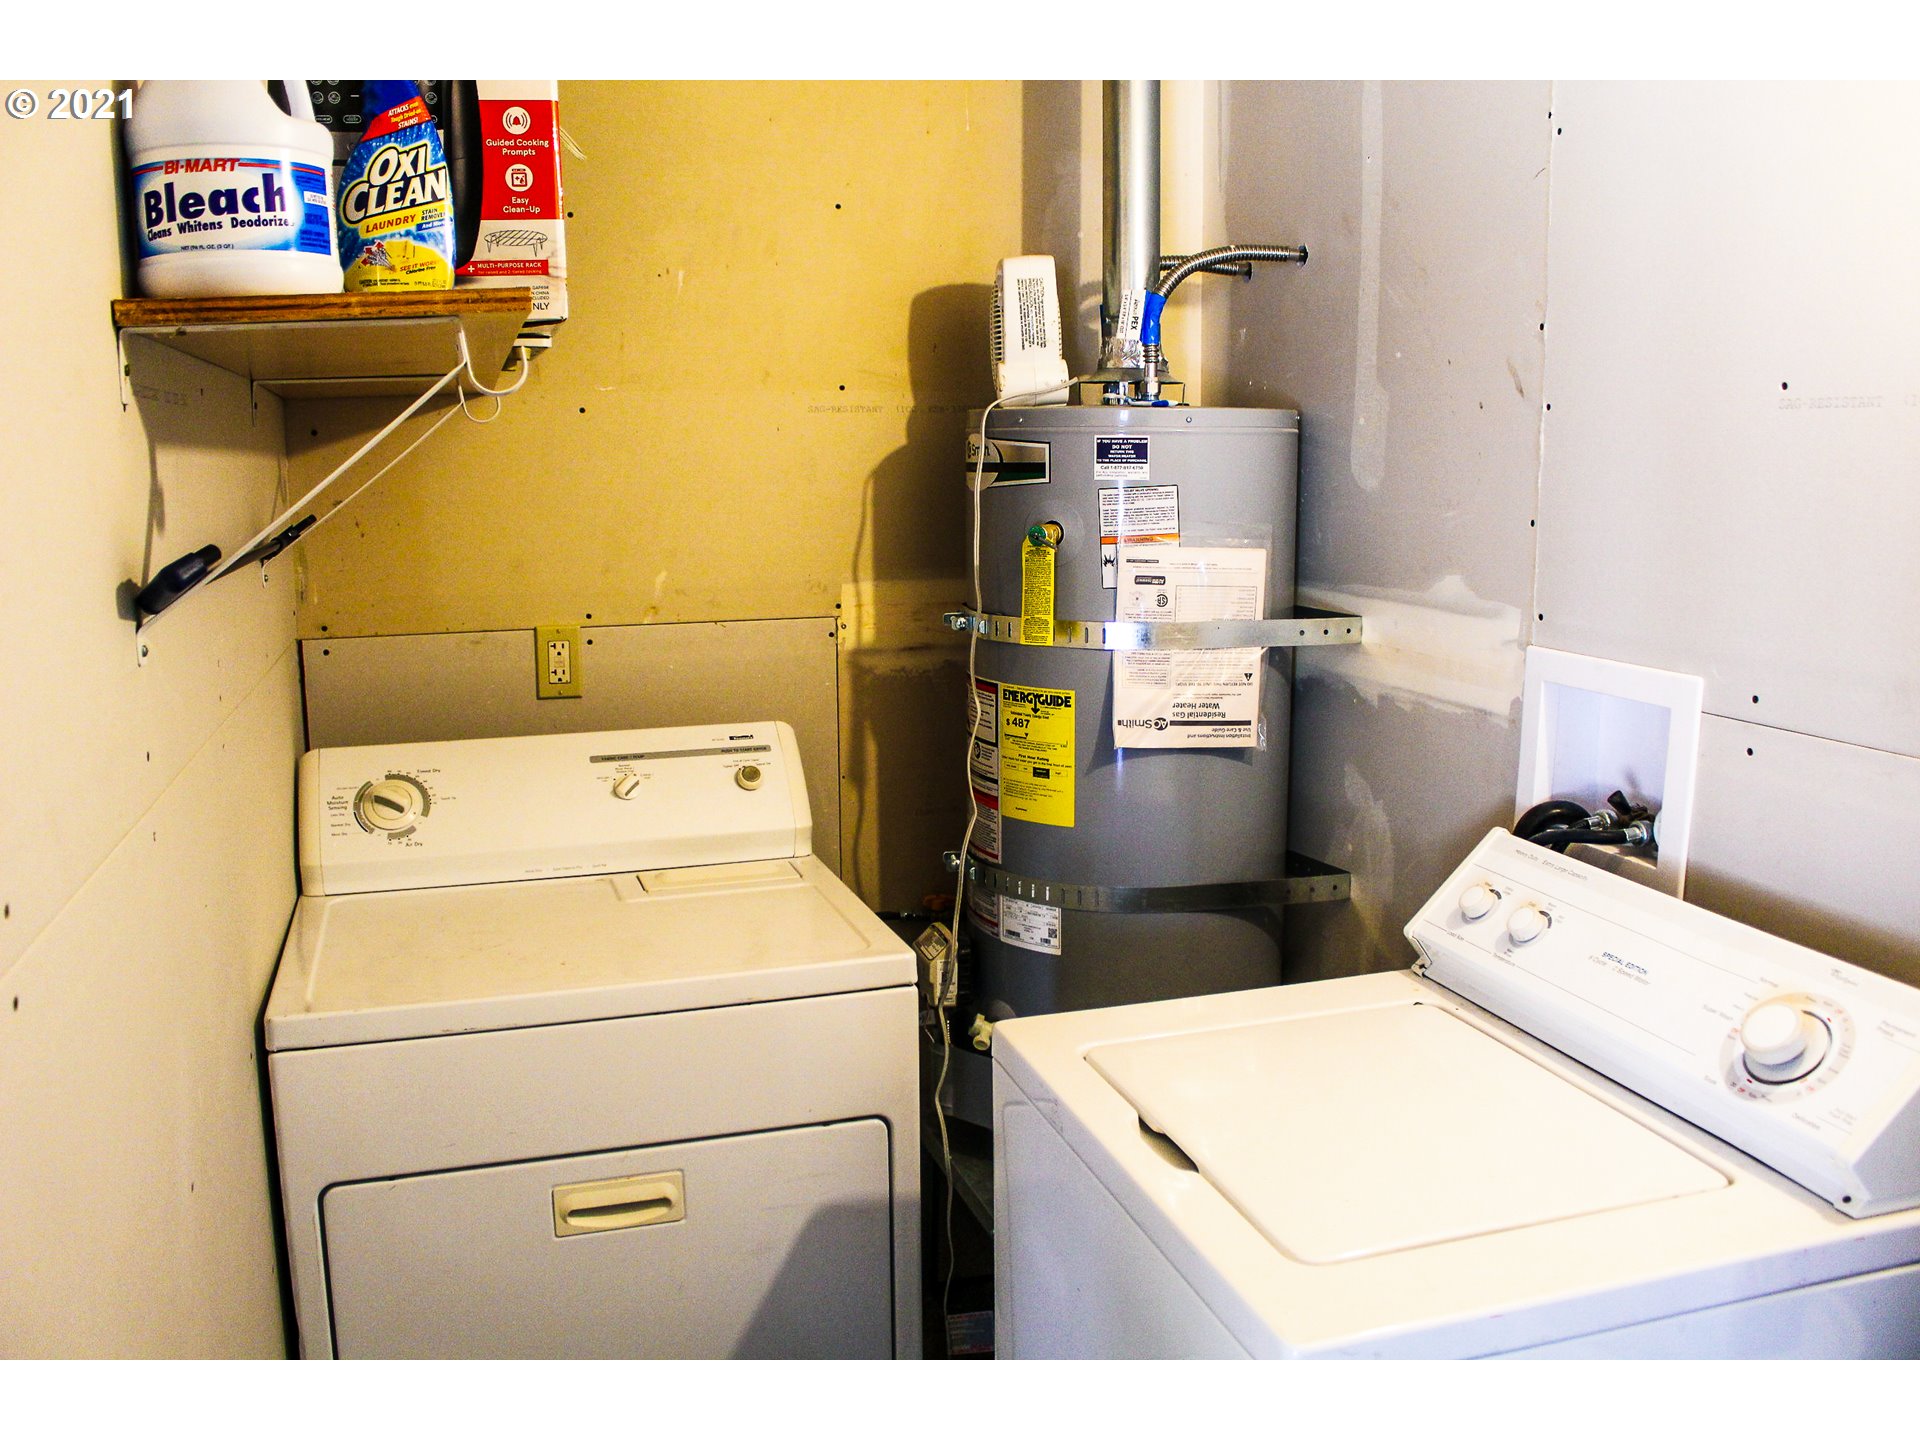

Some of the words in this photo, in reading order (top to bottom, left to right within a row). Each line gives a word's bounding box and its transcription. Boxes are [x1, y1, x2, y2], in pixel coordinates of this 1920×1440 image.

[388, 103, 409, 117] ATTACKS
[398, 116, 418, 130] STAINS!
[486, 138, 514, 146] Guided
[517, 138, 549, 148] Cooking
[502, 148, 536, 157] Prompts
[369, 145, 428, 187] OXI
[143, 172, 287, 229] Bleach
[342, 166, 448, 224] CLEAN
[511, 196, 529, 205] Easy
[421, 208, 438, 216] STAIN
[502, 206, 541, 215] Clean-Up
[147, 226, 172, 242] Cleans
[176, 220, 223, 235] Whitens
[230, 214, 295, 229] Deodorize
[365, 214, 416, 234] LAUNDRY
[400, 264, 411, 272] SEE
[532, 302, 550, 311] NLY
[1130, 315, 1140, 331] PEX
[1172, 711, 1186, 719] Gas
[1187, 711, 1226, 719] Residential
[1012, 717, 1031, 728] 487
[1602, 951, 1623, 966] SPECIAL
[1625, 962, 1648, 975] EDITION
